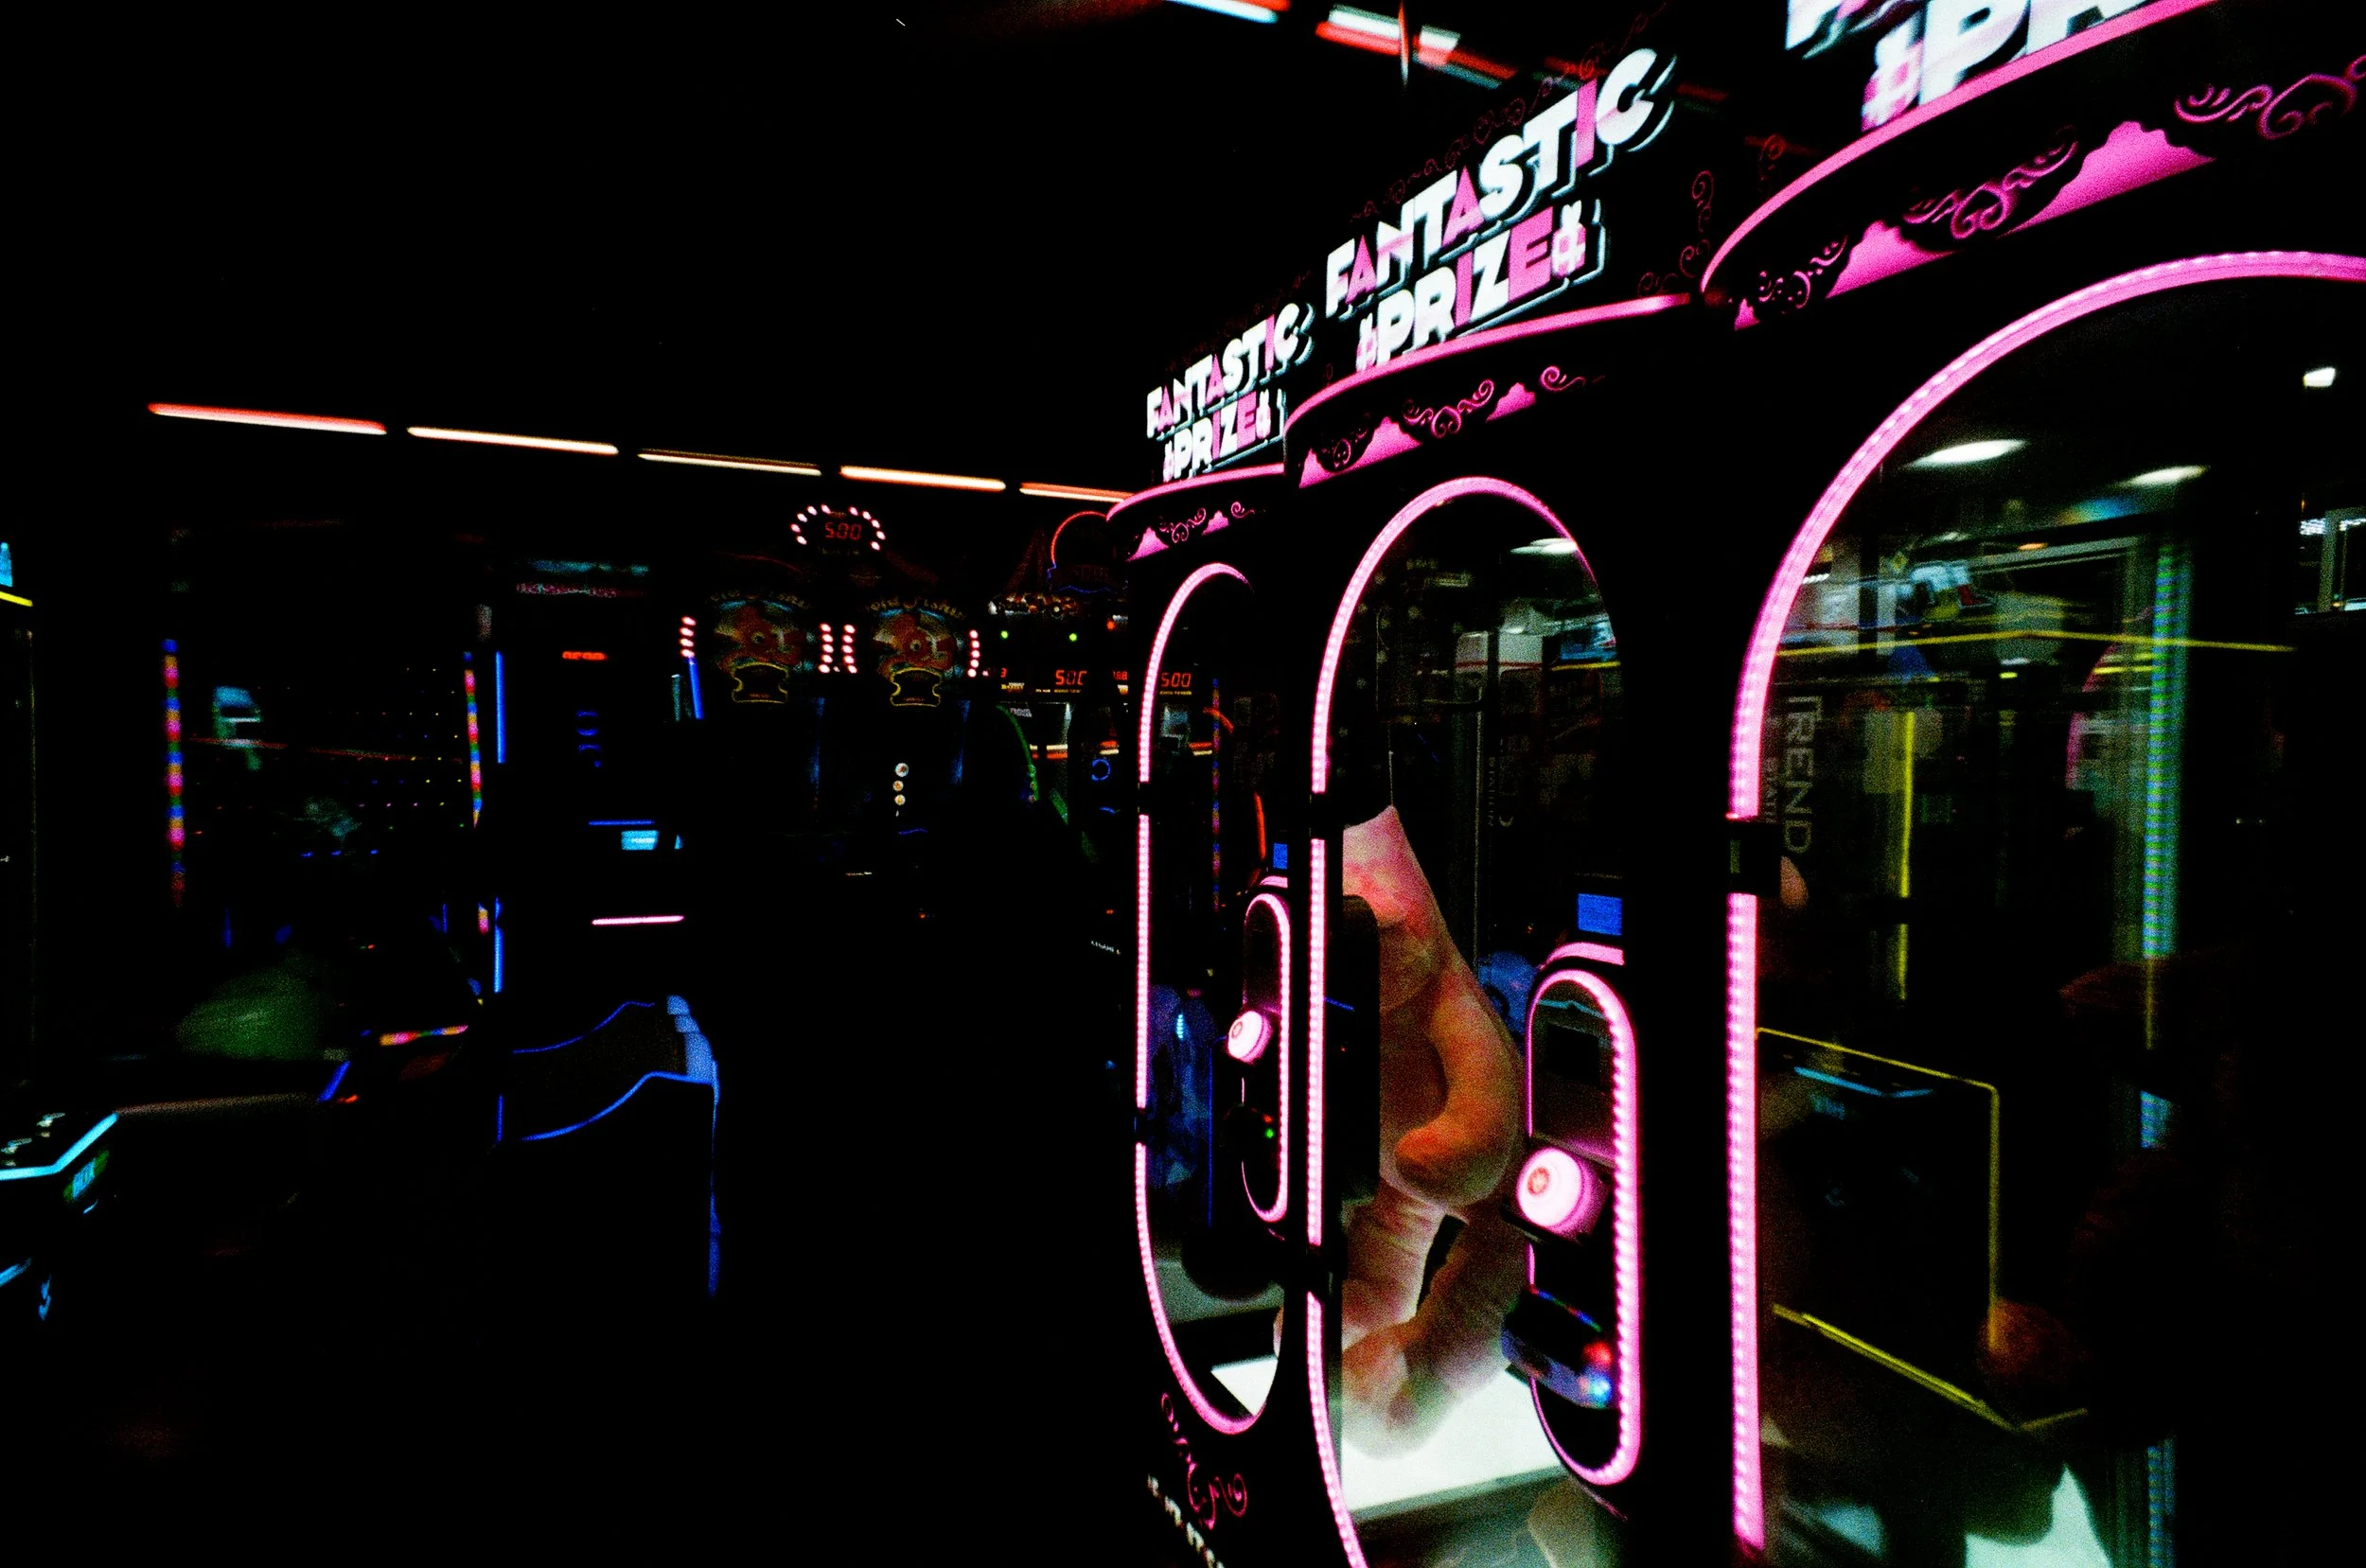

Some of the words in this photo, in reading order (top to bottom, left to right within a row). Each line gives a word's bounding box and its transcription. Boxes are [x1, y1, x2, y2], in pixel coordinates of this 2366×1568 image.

[1326, 47, 1666, 320] FANTASTIC
[1376, 204, 1554, 367] PRIZE
[1146, 302, 1302, 439] FANTASTIC
[1174, 389, 1258, 480] PRIZE
[823, 520, 863, 542] 500
[1159, 671, 1193, 689] 500
[1784, 694, 1823, 854] TREND
